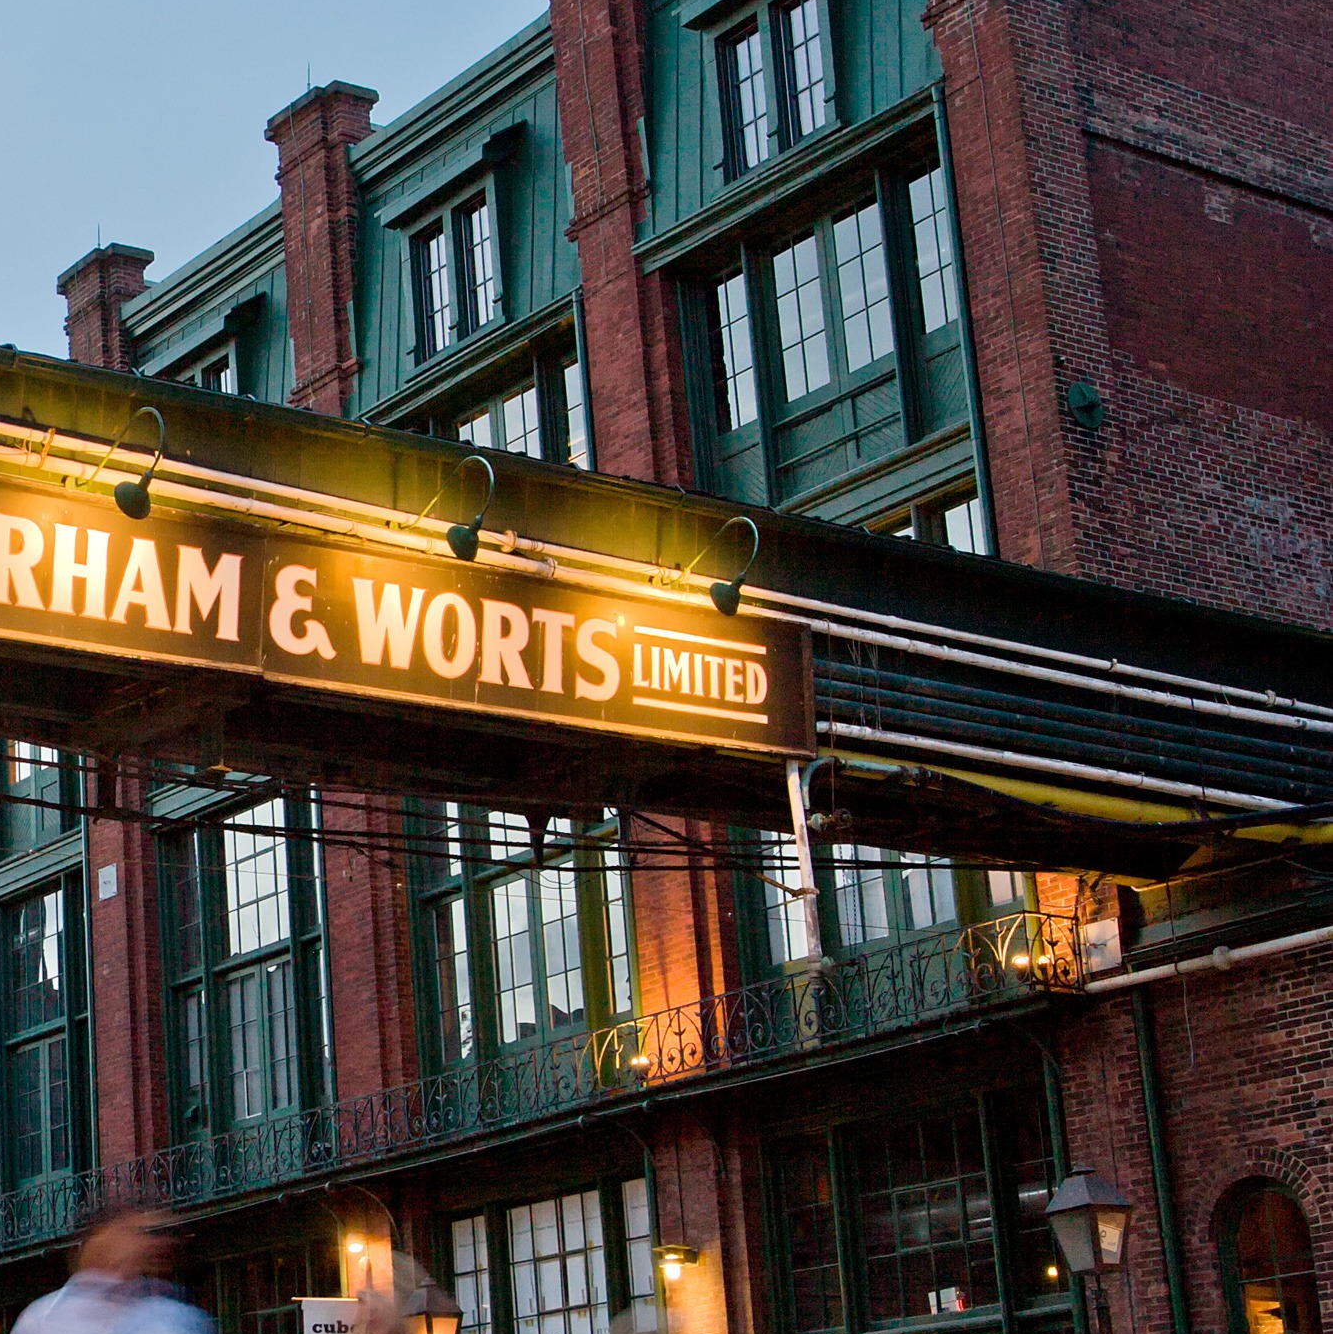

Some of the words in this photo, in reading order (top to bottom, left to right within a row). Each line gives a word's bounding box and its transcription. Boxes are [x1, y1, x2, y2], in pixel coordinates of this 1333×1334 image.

[269, 564, 338, 661] &
[351, 576, 621, 702] WORTS
[632, 643, 768, 705] LIMITED
